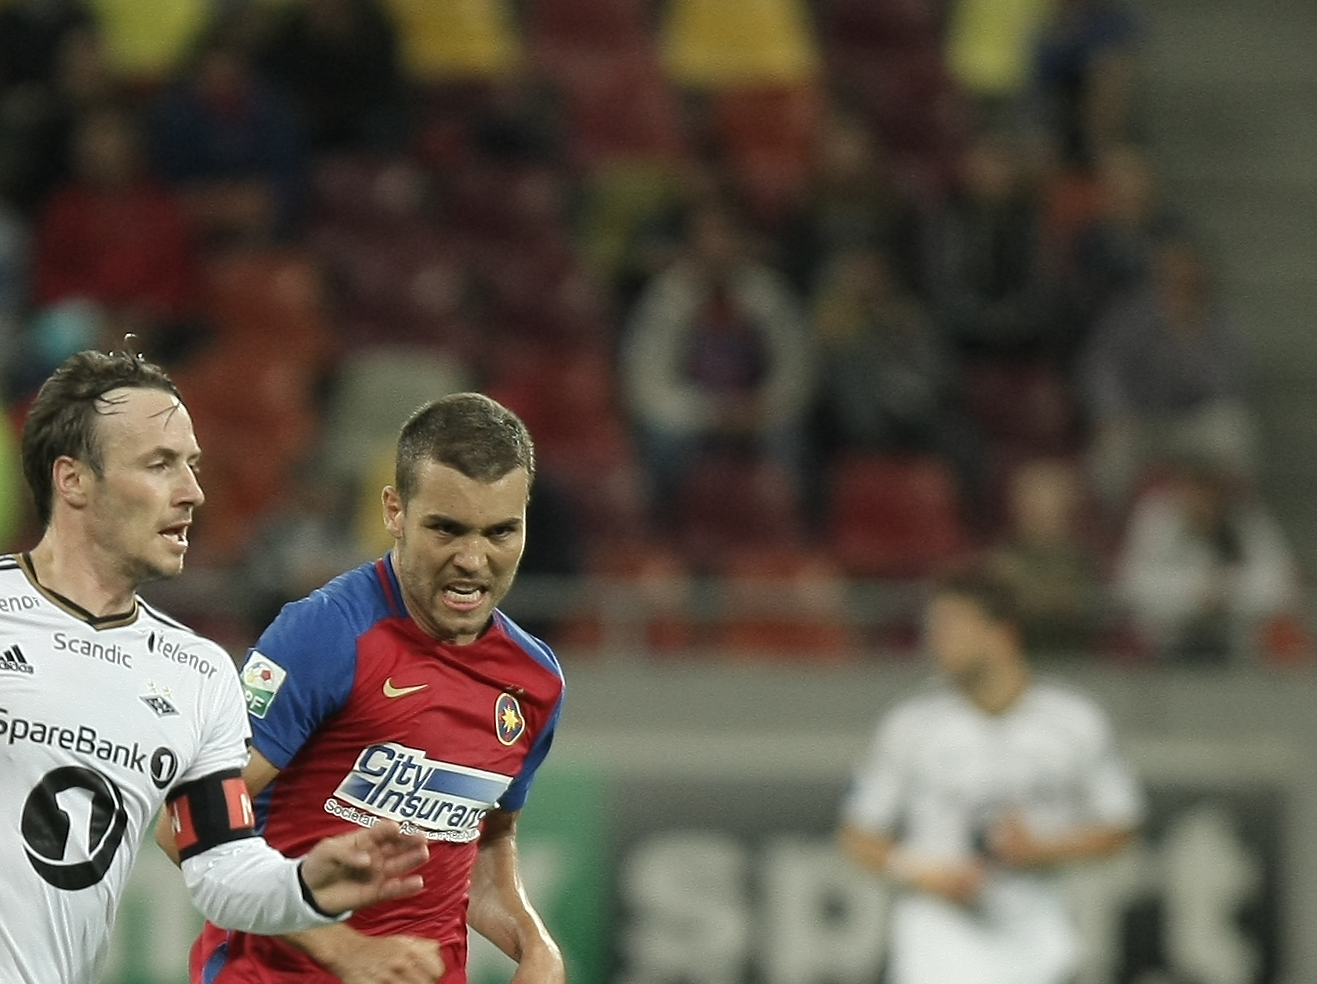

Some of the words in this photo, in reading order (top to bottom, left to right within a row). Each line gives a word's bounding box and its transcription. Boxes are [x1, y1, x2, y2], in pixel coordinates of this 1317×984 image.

[53, 632, 133, 669] Scandic
[156, 634, 218, 679] telenor
[358, 744, 434, 793] City
